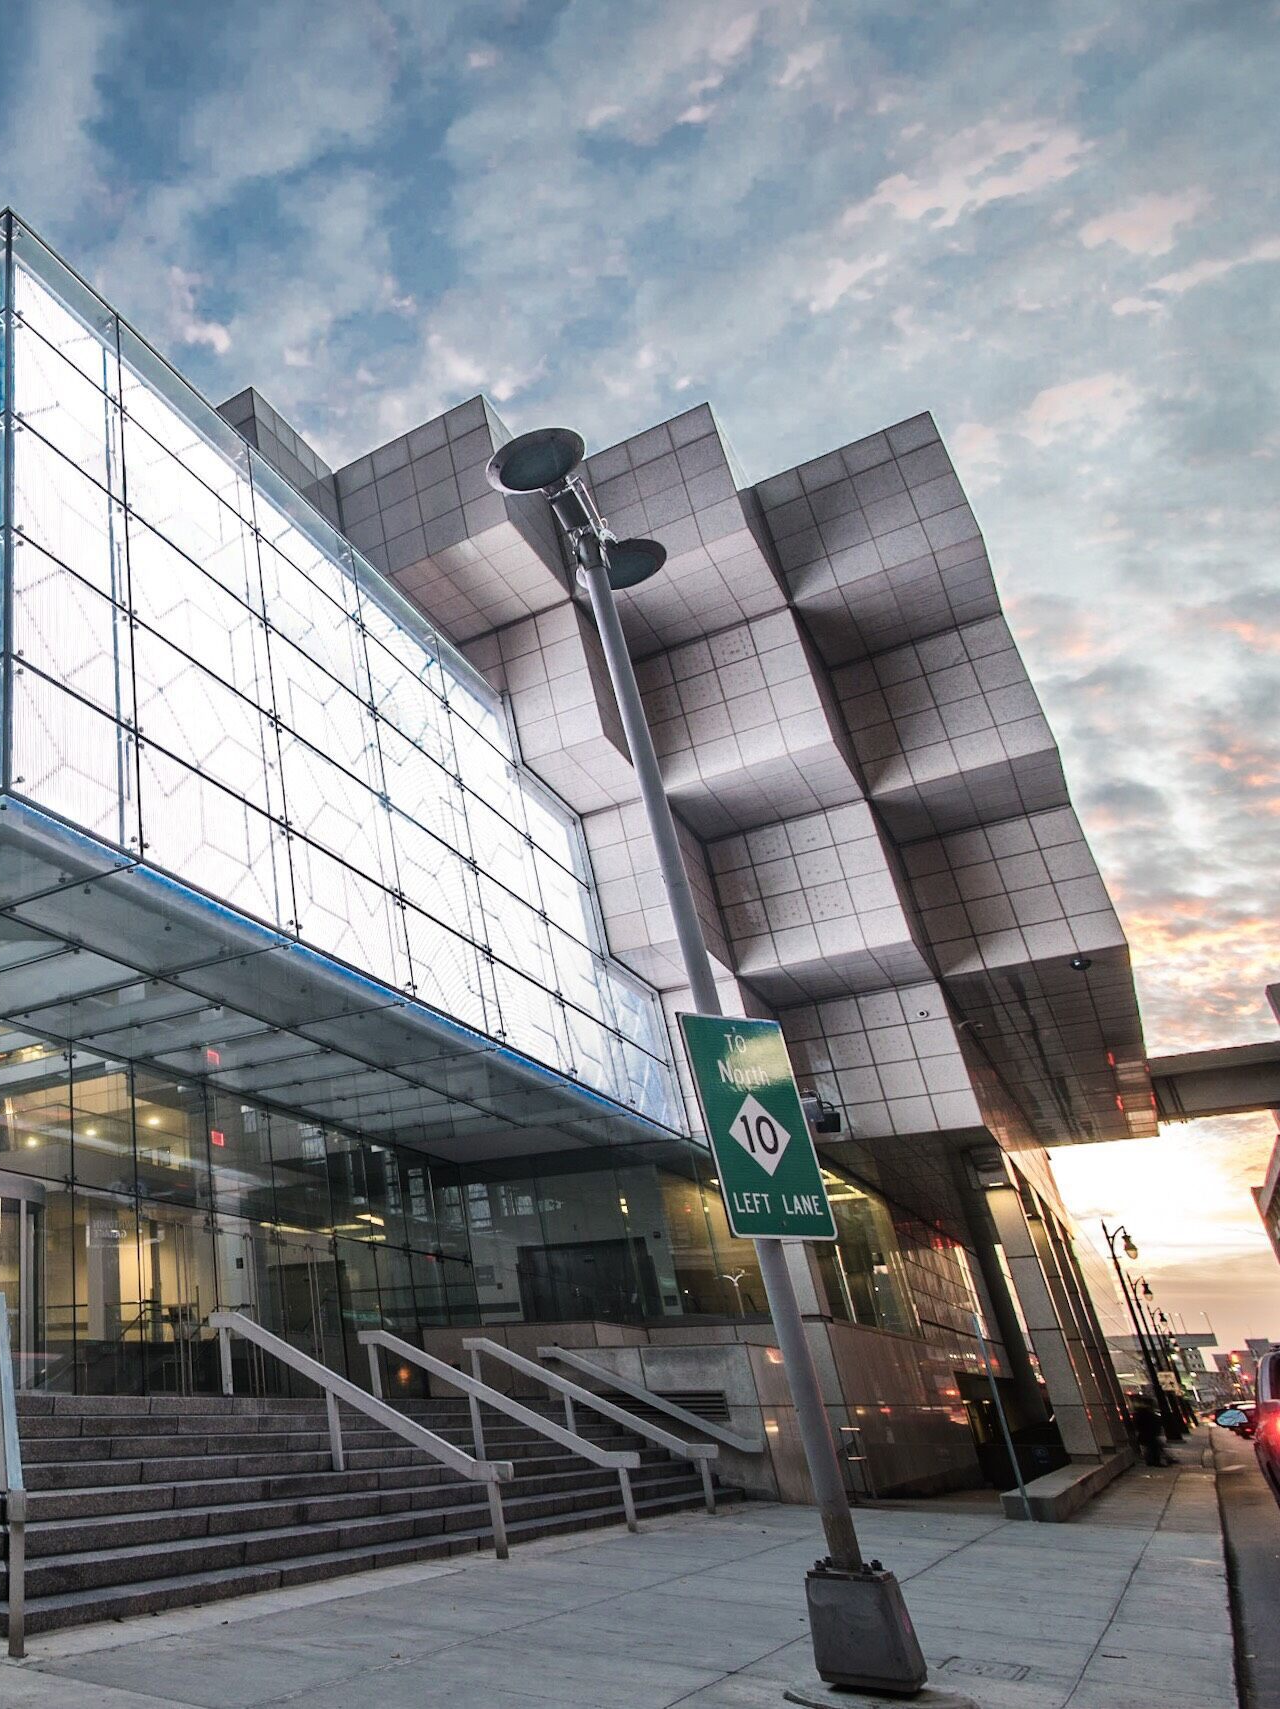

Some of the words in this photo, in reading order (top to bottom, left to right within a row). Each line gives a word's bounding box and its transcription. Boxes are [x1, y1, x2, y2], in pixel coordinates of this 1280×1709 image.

[723, 1034, 747, 1053] TO
[717, 1059, 770, 1086] North
[740, 1115, 779, 1155] 10
[733, 1192, 771, 1214] LEFT
[781, 1193, 824, 1216] LANE
